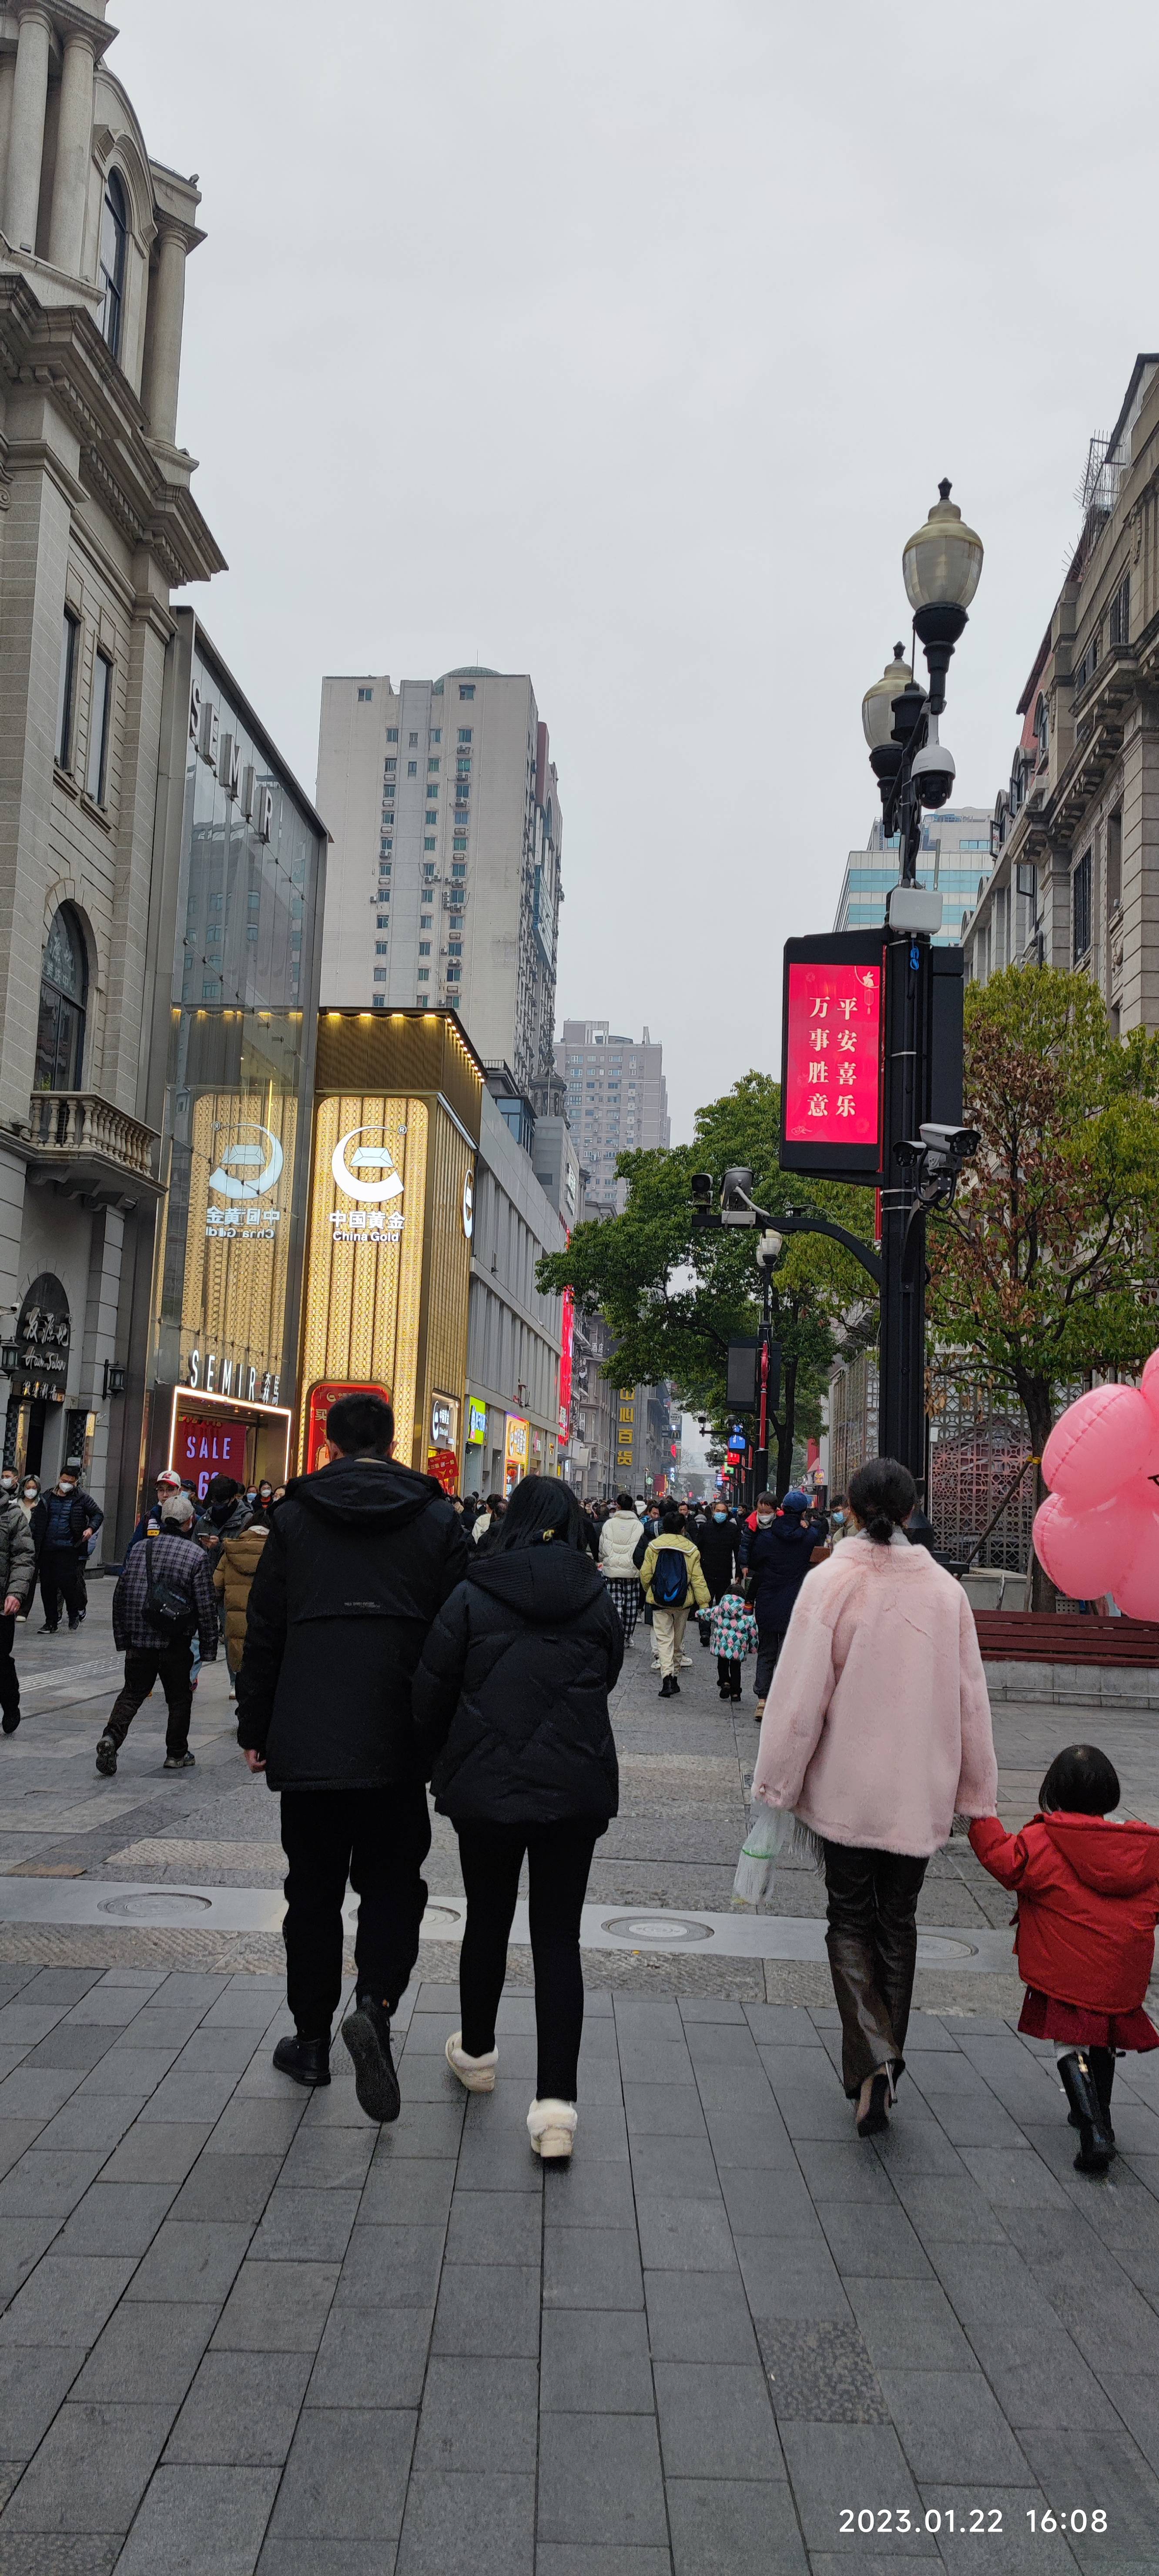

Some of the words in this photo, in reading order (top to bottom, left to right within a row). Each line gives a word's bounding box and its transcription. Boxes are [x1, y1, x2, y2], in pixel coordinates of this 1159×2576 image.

[189, 679, 274, 844] SEMIR
[807, 996, 831, 1117] 万事胜意
[835, 996, 858, 1118] 平安喜乐
[329, 1210, 406, 1230] 中国黄金
[333, 1231, 368, 1241] China
[370, 1231, 399, 1242] Gold
[191, 1349, 256, 1401] SEMIR
[186, 1436, 231, 1459] SALE
[617, 1387, 636, 1466] 中心百货
[198, 1471, 219, 1500] 6
